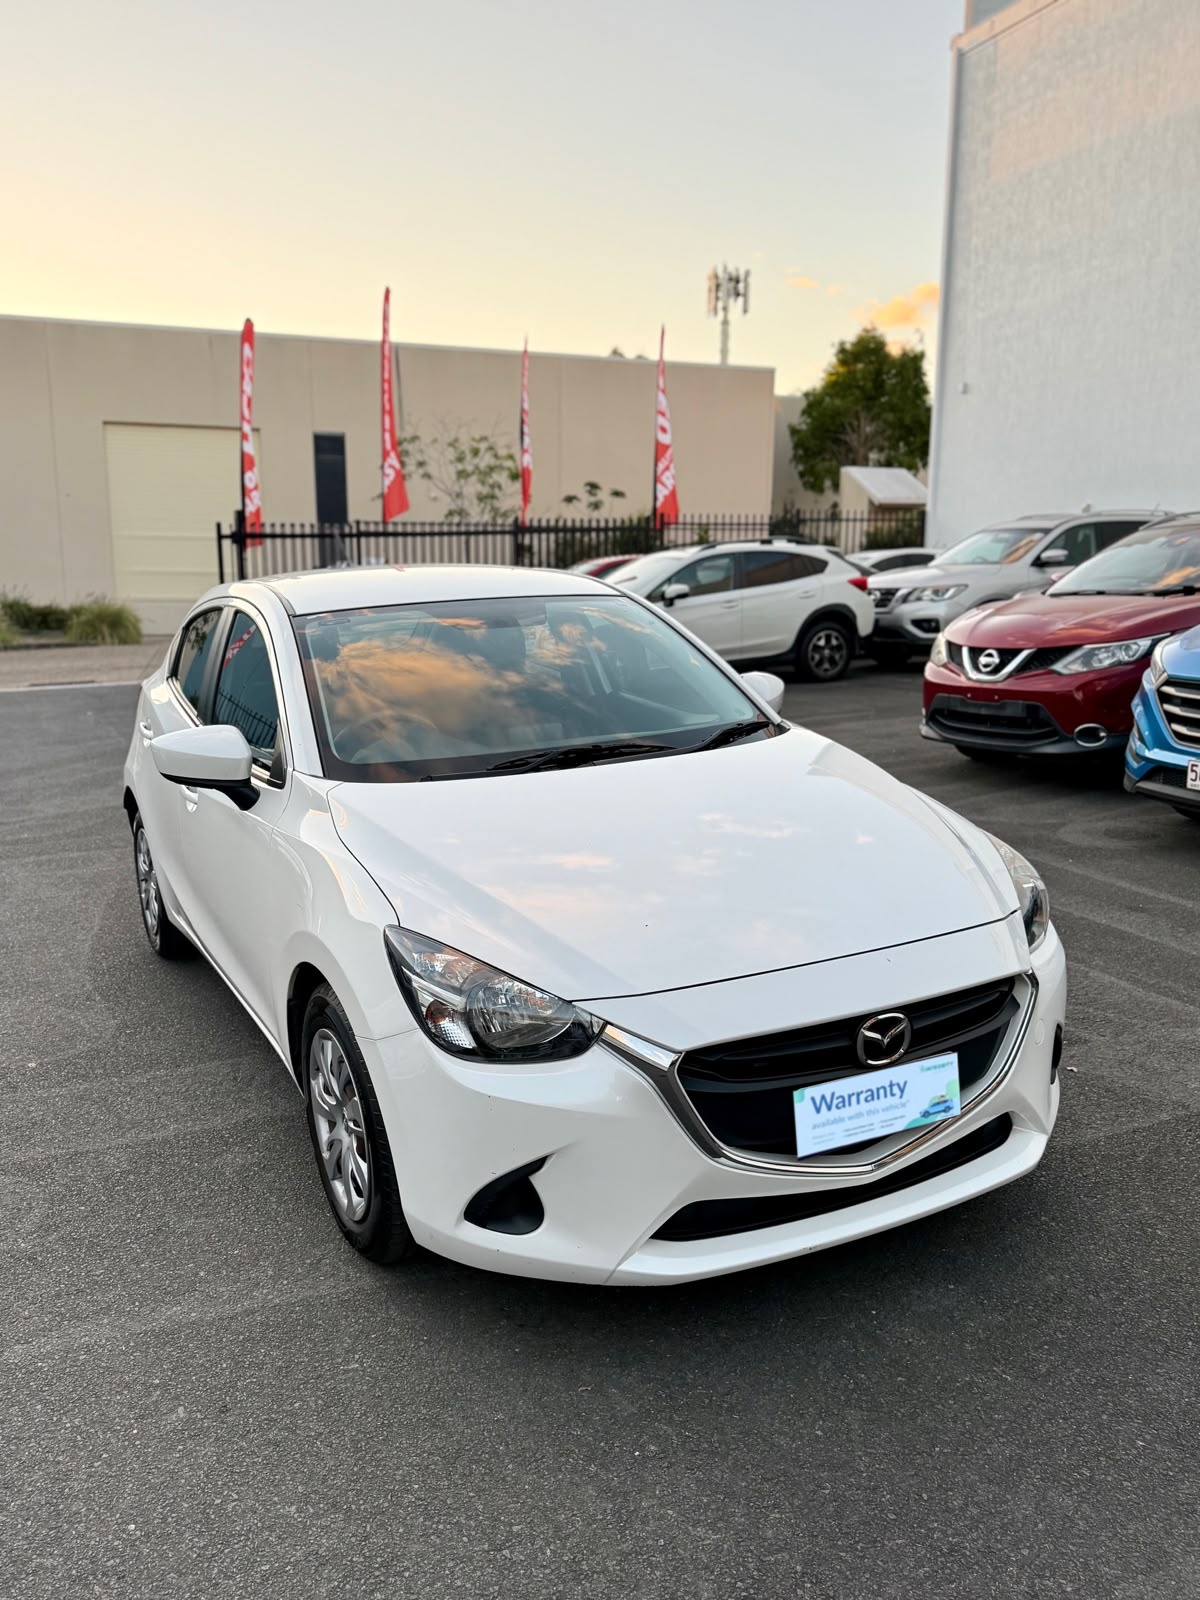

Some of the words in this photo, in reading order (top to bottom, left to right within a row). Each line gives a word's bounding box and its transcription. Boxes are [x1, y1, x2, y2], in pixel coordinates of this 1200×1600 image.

[810, 1080, 908, 1115] Warranty
[811, 1114, 846, 1130] available
[847, 1110, 865, 1121] with
[866, 1107, 880, 1117] this
